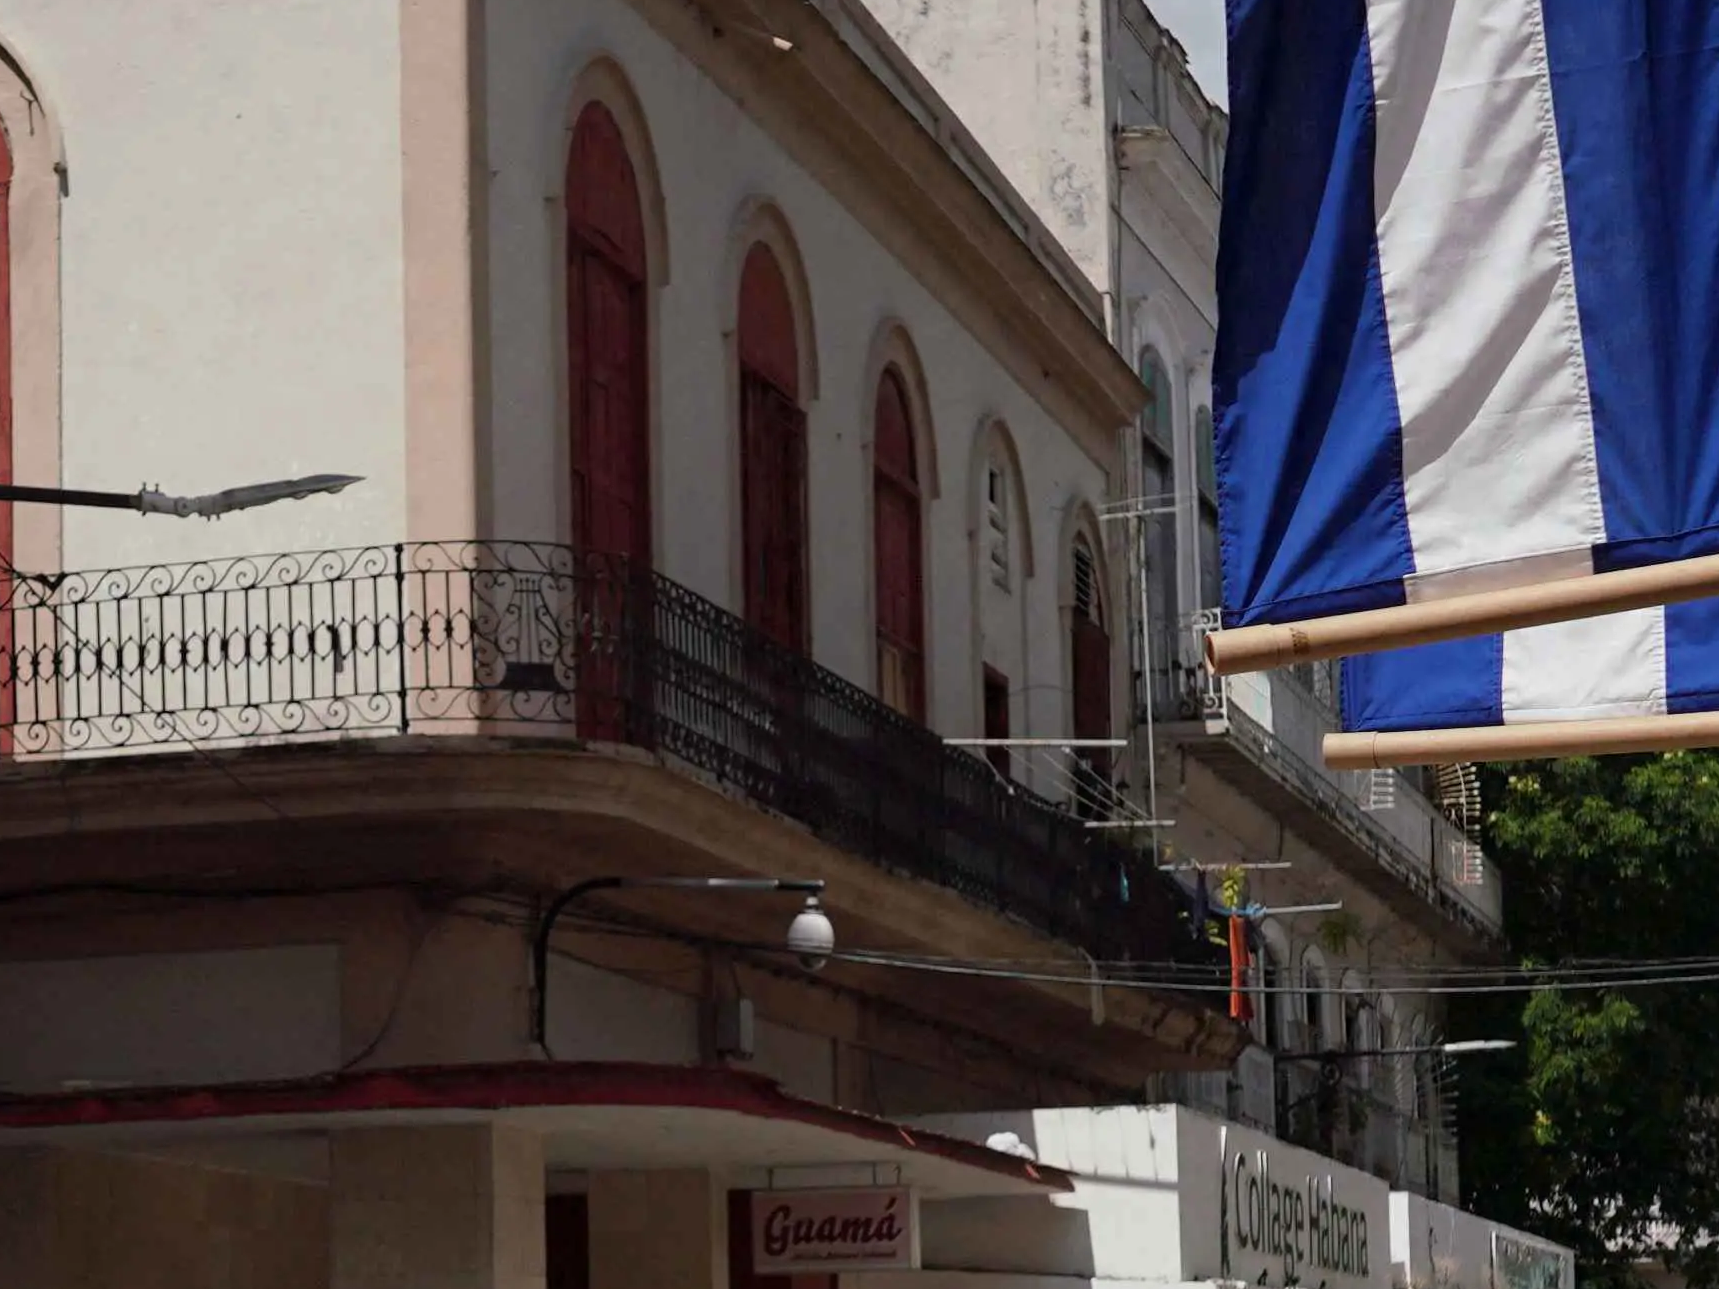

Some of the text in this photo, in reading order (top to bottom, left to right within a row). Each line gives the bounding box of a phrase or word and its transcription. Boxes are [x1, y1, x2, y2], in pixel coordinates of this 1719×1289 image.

[764, 1196, 903, 1257] Guamá
[1234, 1150, 1304, 1280] Collage
[1307, 1174, 1369, 1278] Habana
